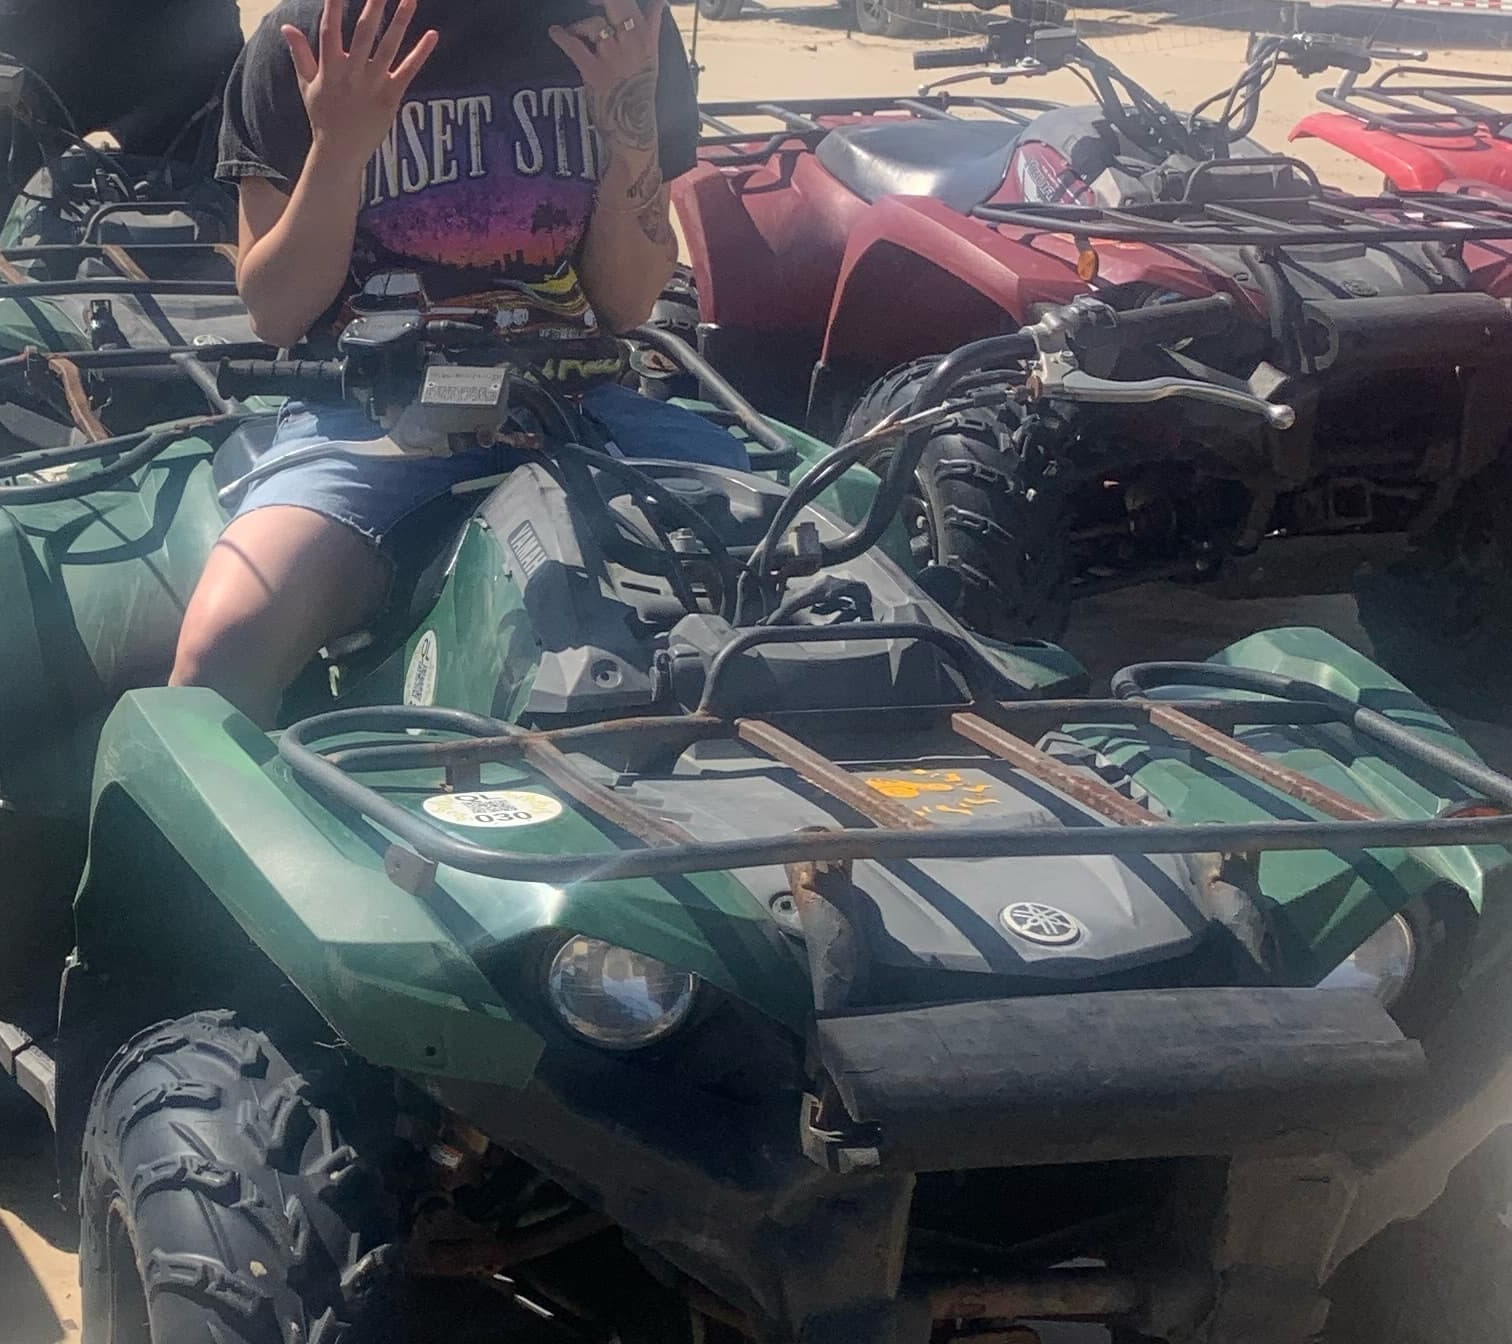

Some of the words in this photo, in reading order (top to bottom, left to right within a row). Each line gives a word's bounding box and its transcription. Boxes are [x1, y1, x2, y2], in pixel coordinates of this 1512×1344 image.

[360, 95, 492, 207] NSET
[510, 522, 548, 578] YAMAH
[475, 811, 532, 823] 030
